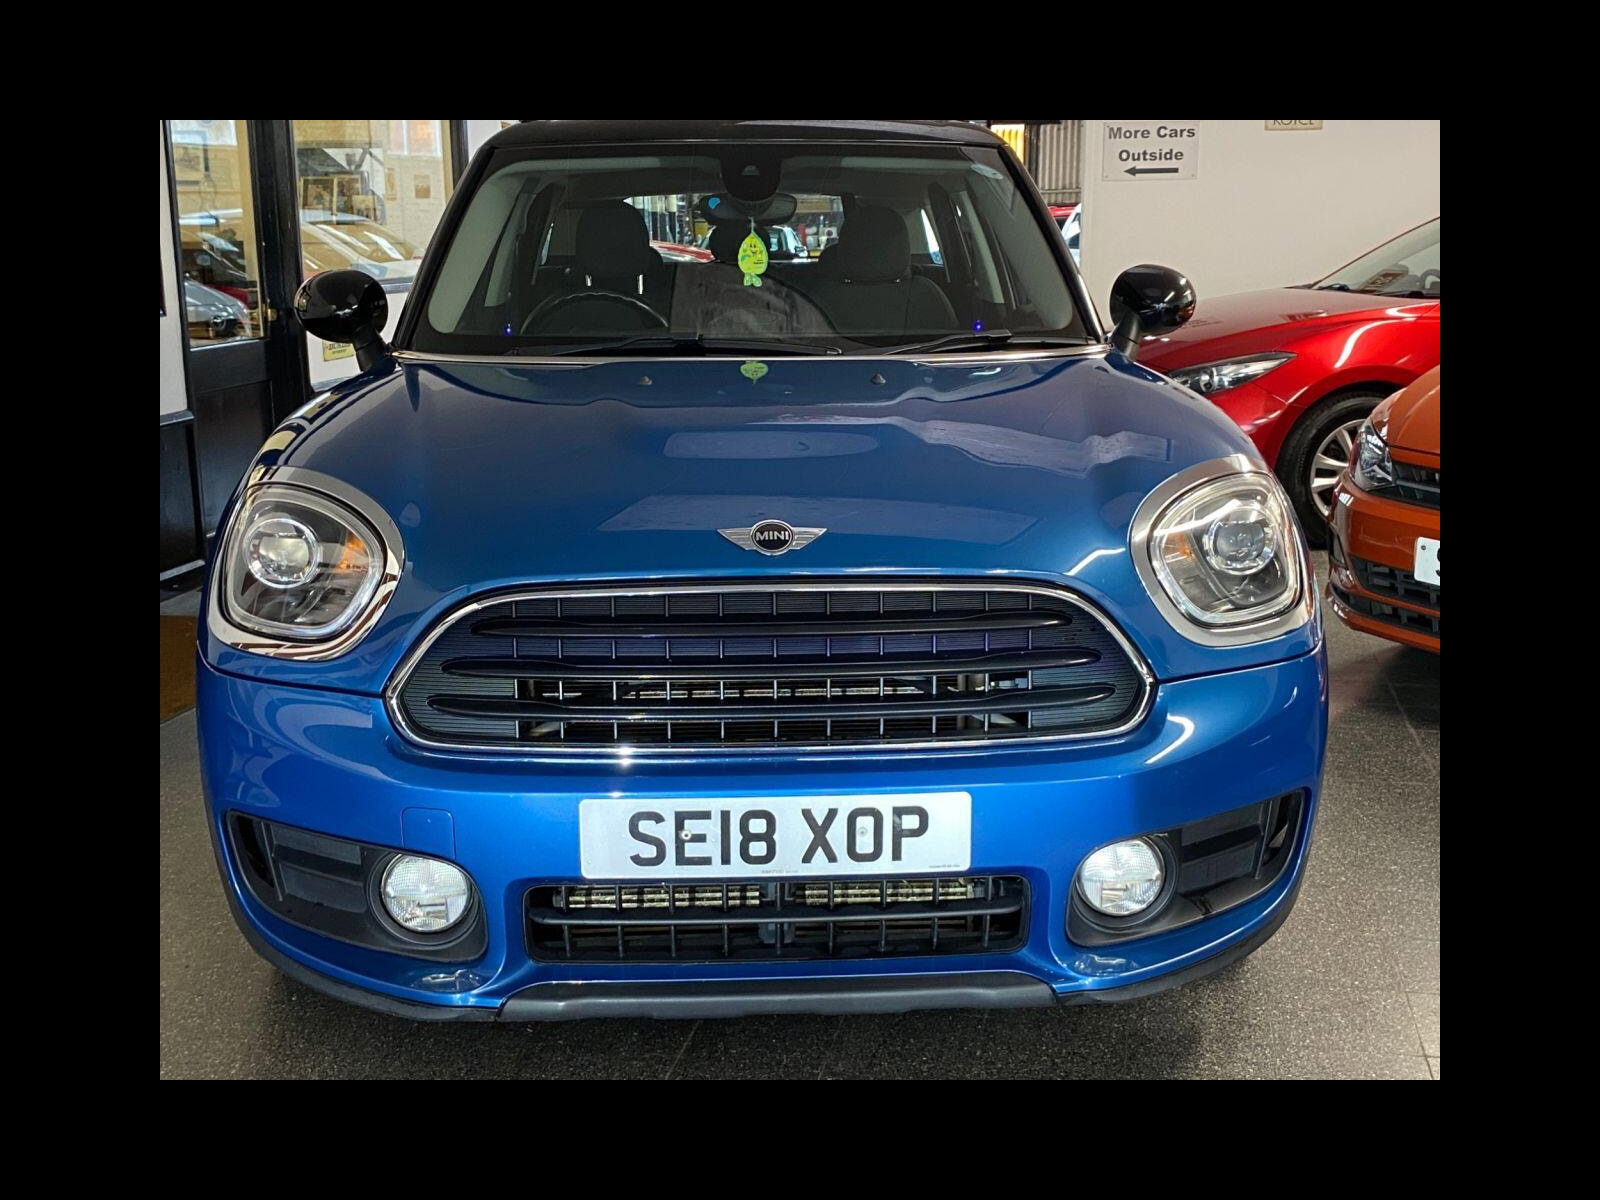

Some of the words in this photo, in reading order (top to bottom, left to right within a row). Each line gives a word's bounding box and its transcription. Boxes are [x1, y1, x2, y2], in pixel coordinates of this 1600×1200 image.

[1108, 126, 1150, 140] More
[1156, 125, 1196, 139] Cars
[1118, 148, 1184, 162] Outside
[756, 530, 789, 541] MINI
[628, 809, 777, 867] SE18
[801, 805, 930, 864] XOP
